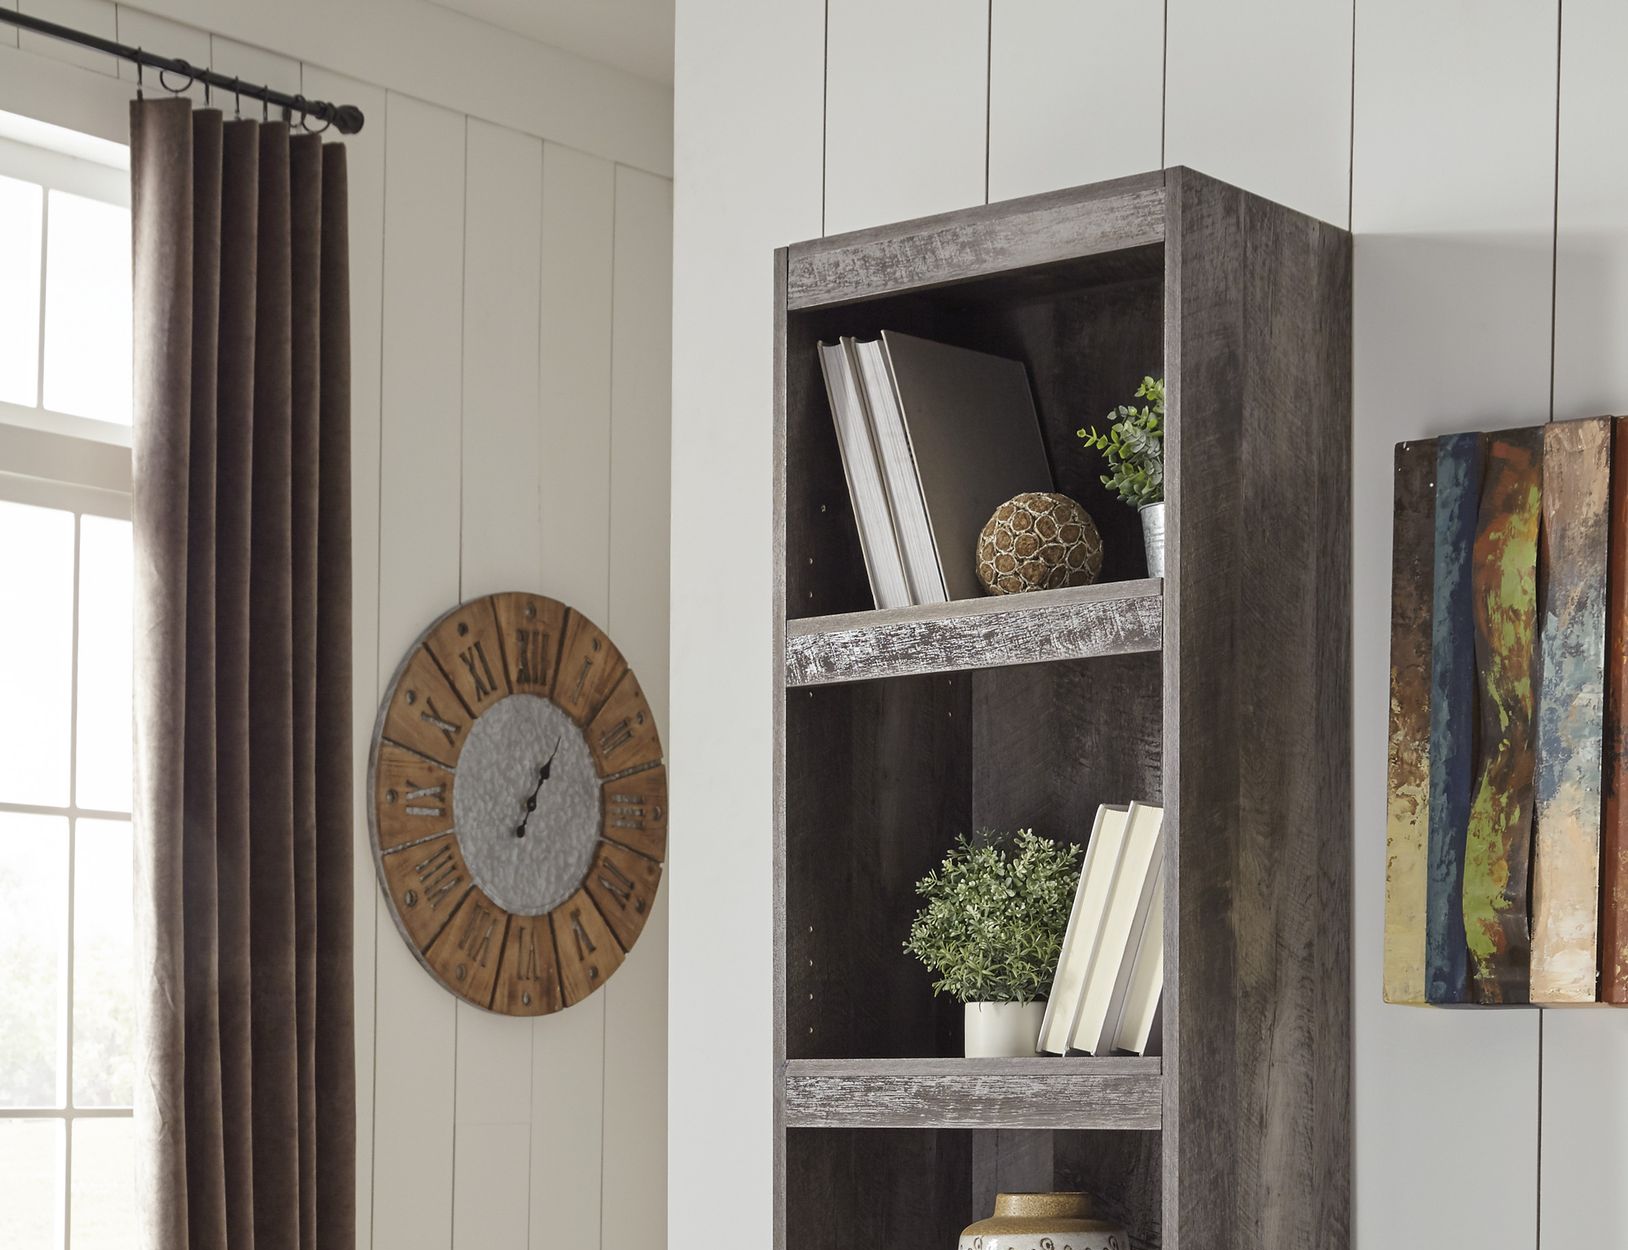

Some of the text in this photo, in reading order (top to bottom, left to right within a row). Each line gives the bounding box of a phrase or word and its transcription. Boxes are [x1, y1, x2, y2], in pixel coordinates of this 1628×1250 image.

[459, 641, 497, 701] XI
[516, 630, 549, 685] XII
[421, 698, 460, 746] X
[600, 719, 634, 755] II
[406, 780, 446, 817] IX
[611, 794, 647, 829] III
[416, 844, 461, 909] VIII
[597, 855, 635, 911] IV
[517, 926, 541, 982] VI
[570, 908, 597, 961] V
